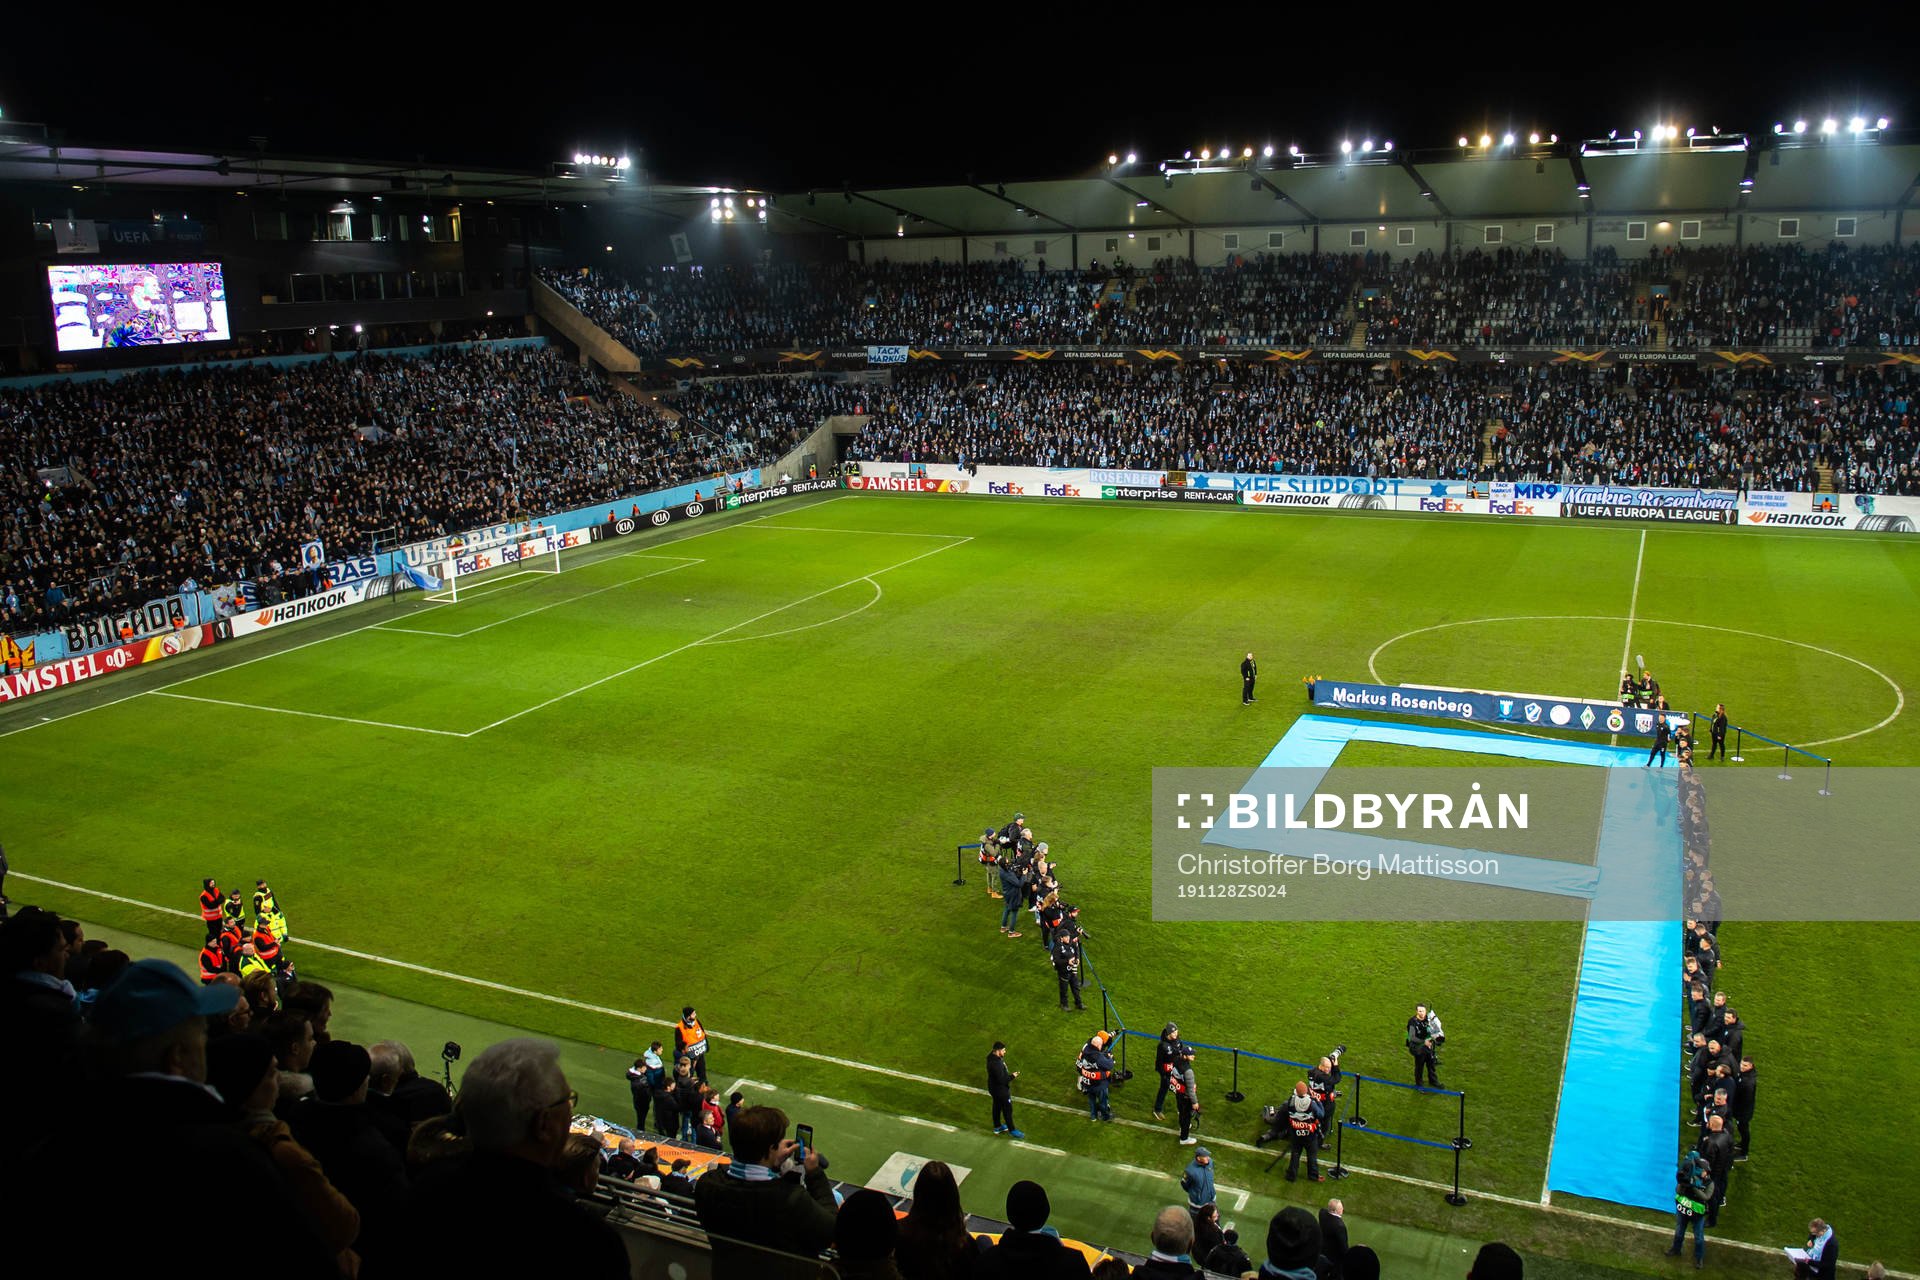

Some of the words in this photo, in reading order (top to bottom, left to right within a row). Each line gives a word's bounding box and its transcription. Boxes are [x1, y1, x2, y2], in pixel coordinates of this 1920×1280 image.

[112, 231, 151, 243] UEFA
[868, 354, 906, 363] MARKUS
[877, 346, 900, 355] TACK
[866, 477, 924, 491] AMSTEL
[988, 482, 1024, 494] FedEx
[1044, 484, 1080, 496] FedEx
[1288, 477, 1404, 496] SUPPORT
[1514, 483, 1558, 499] MR9
[729, 486, 788, 506] enterprise
[792, 479, 837, 493] RENT-A-CAR
[1106, 487, 1178, 500] enterprise
[1184, 491, 1234, 501] RENT-A-CAR
[1566, 485, 1632, 505] Markus
[1637, 489, 1734, 509] Rosenberg
[1420, 498, 1464, 512] FedEx
[1489, 500, 1534, 515] FedEx
[1578, 505, 1612, 517] UEFA
[1614, 507, 1666, 519] EUROPA
[1668, 509, 1720, 521] LEAGUE
[547, 532, 579, 551] FedEx
[502, 543, 536, 563] FedEx
[456, 553, 492, 575] FedEx
[0, 654, 104, 700] AMSTEL
[1333, 687, 1387, 706] Markus
[1391, 692, 1473, 718] Rosenberg
